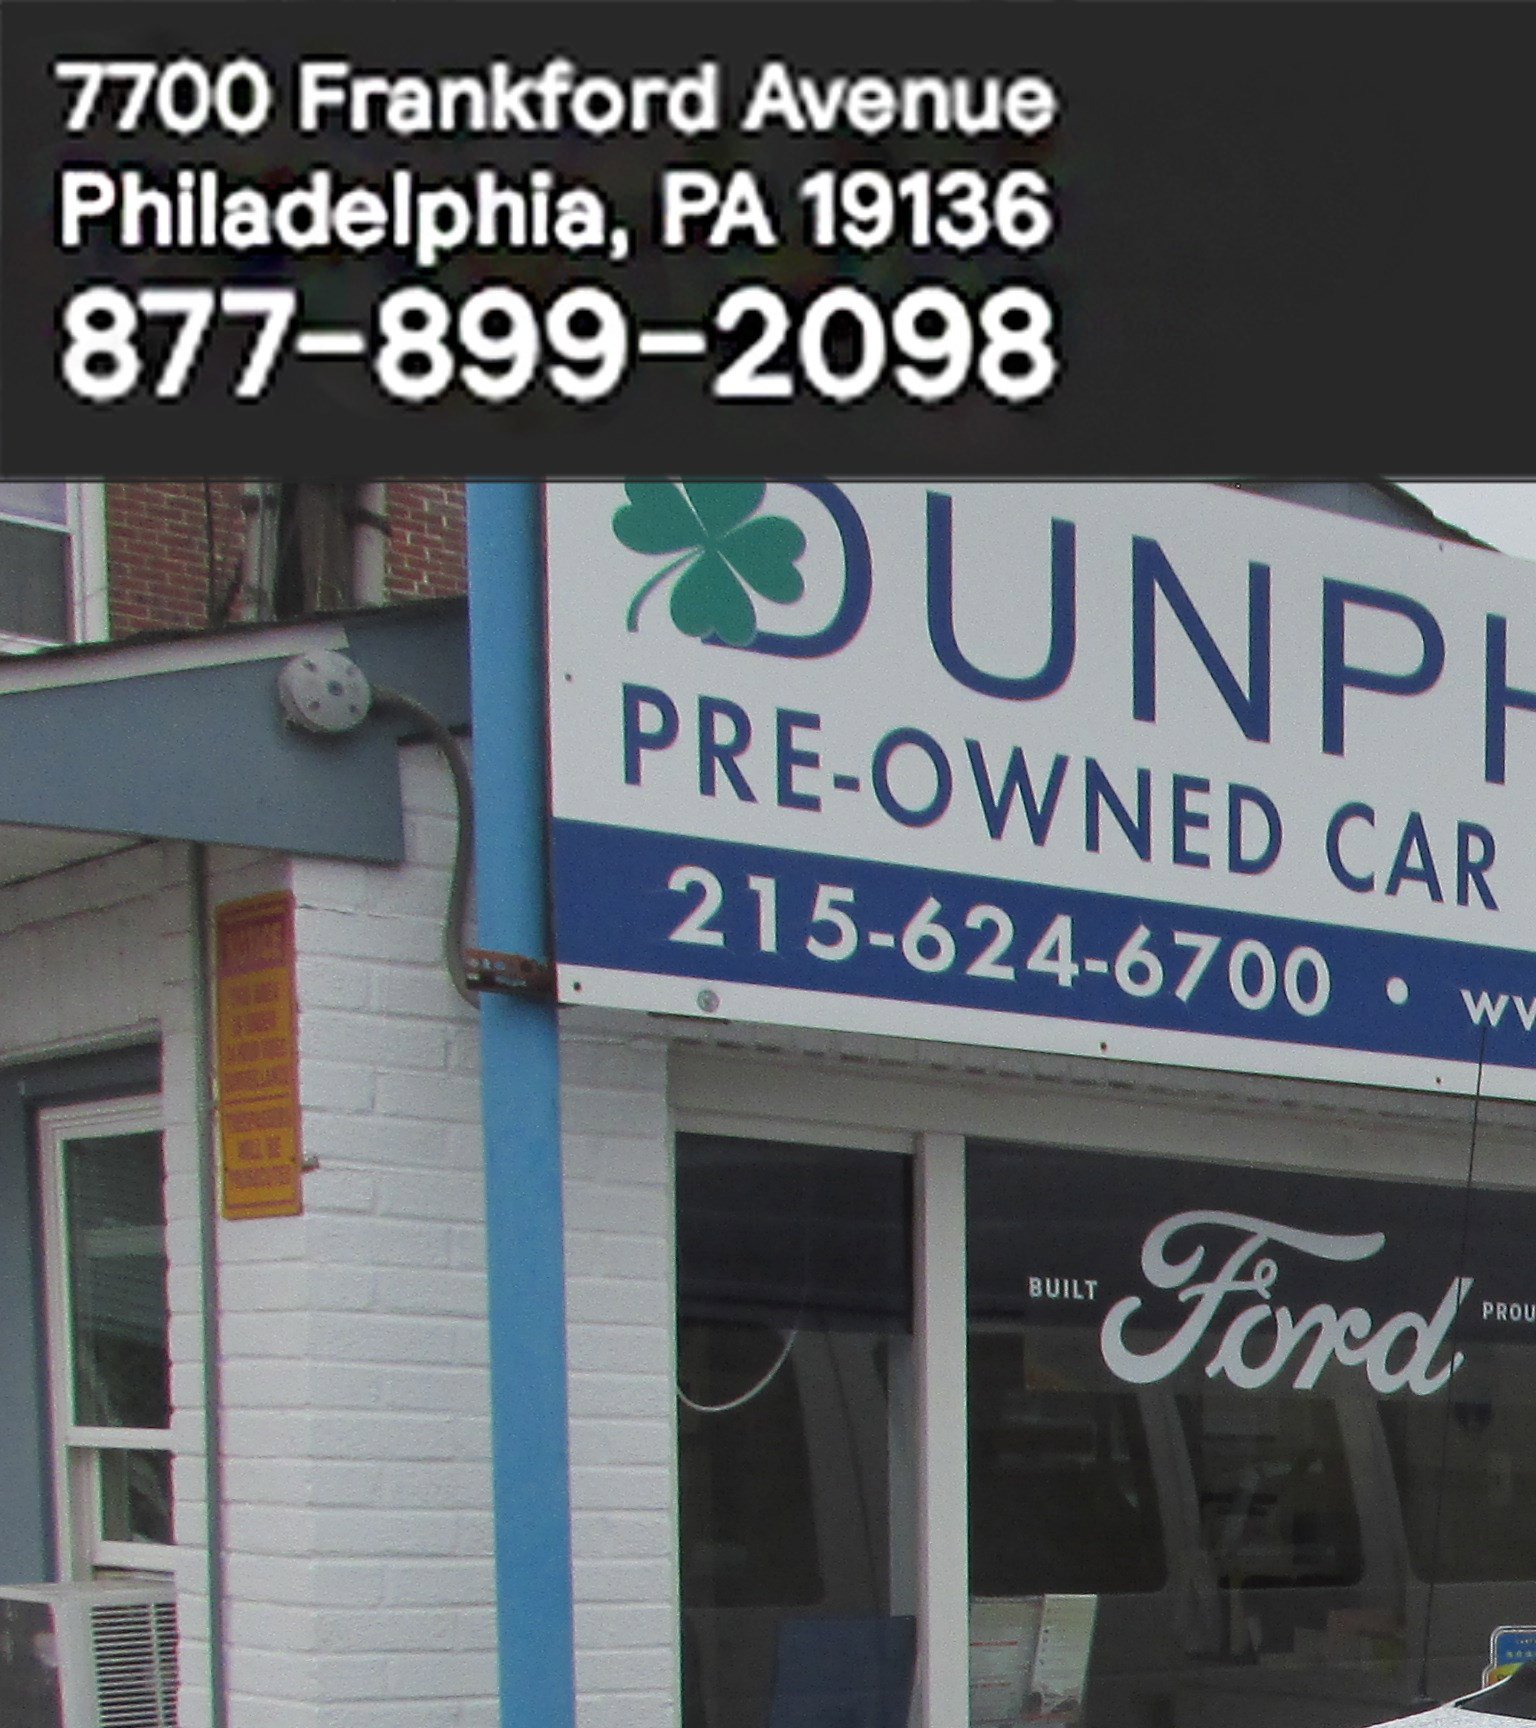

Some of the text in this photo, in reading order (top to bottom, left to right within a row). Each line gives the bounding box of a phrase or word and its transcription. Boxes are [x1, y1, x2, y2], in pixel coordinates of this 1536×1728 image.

[622, 682, 1283, 877] PRE-OWNED
[1325, 802, 1500, 912] CAR
[667, 865, 1332, 1017] 215-624-6700
[1028, 1276, 1098, 1300] BUILT
[1101, 1209, 1474, 1396] Ford
